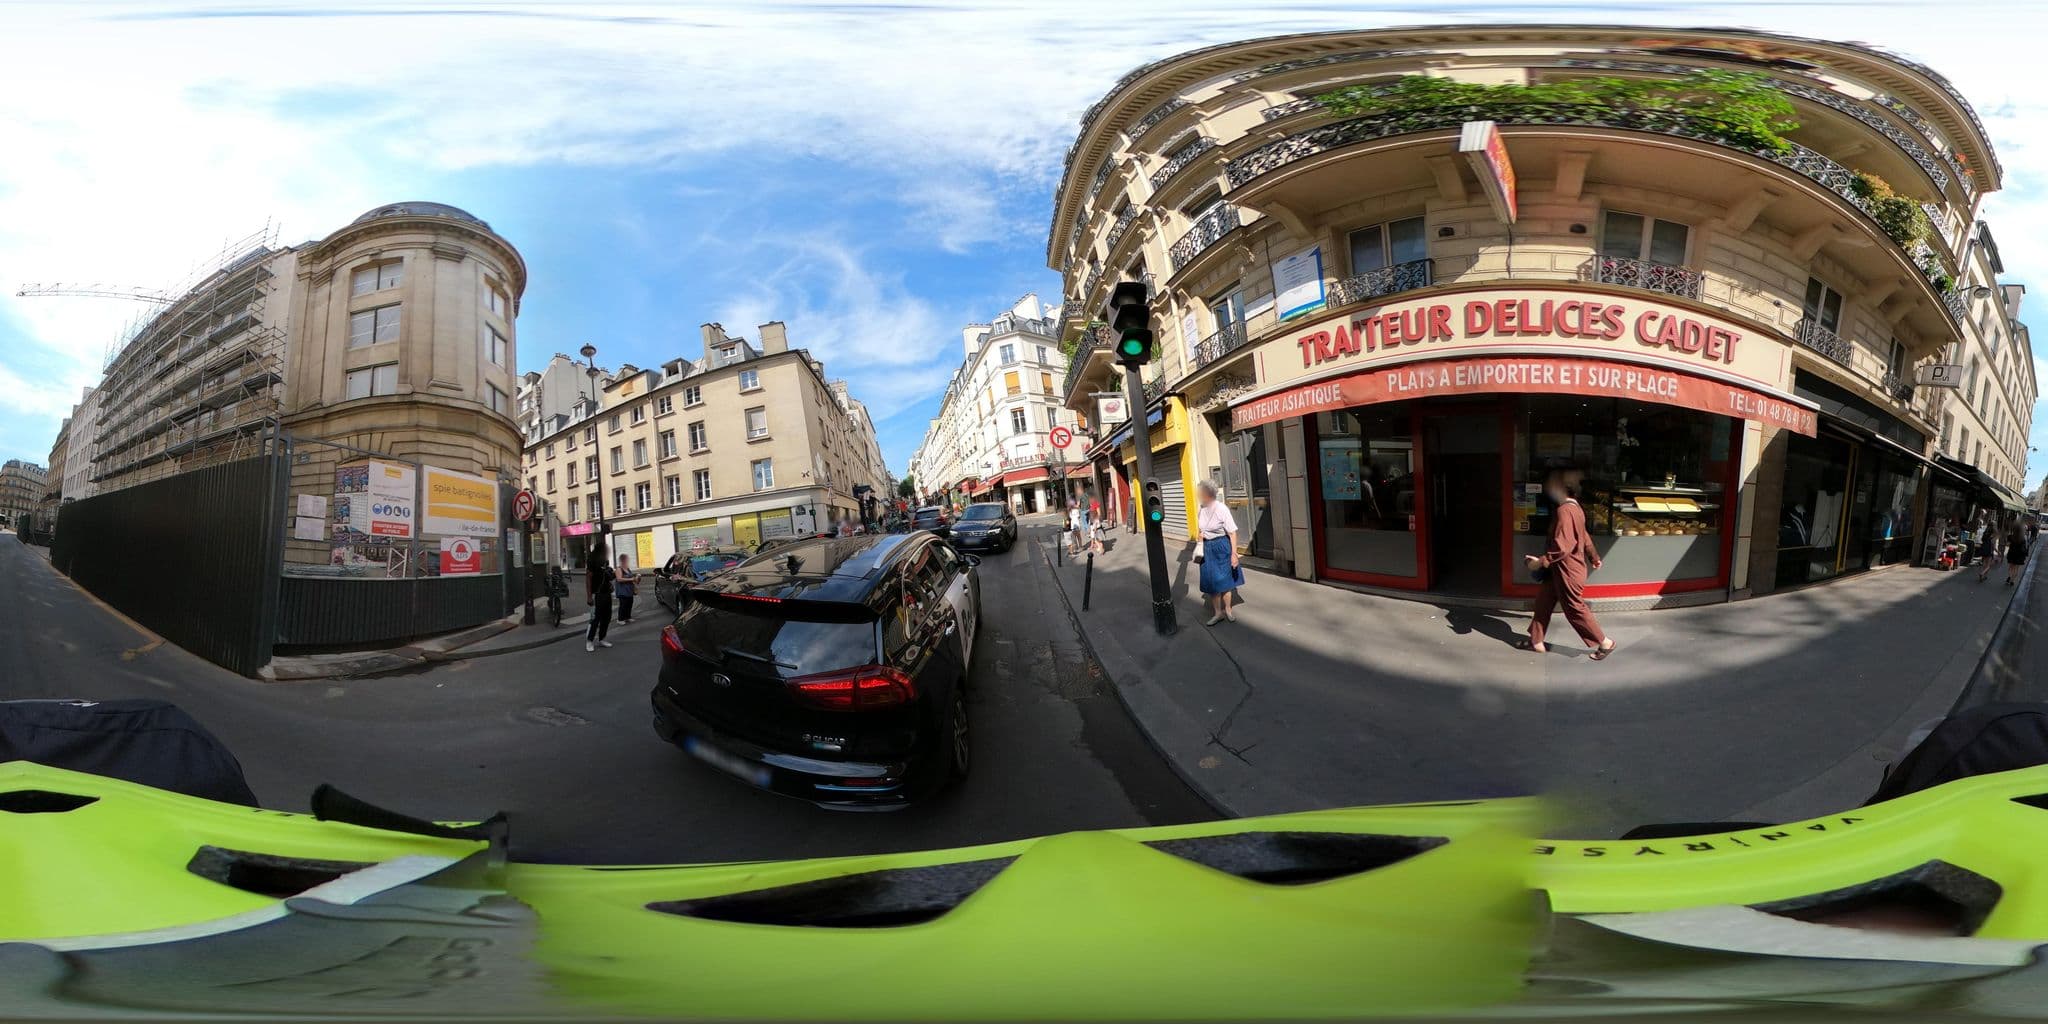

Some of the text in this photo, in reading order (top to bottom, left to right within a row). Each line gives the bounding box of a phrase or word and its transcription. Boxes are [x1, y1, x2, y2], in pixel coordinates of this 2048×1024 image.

[1298, 304, 1454, 366] TRAITEUR
[1465, 299, 1625, 338] DELICES
[1636, 310, 1742, 362] CADET
[1388, 363, 1679, 397] PLATS A EMPORTER ET SUR PLACE
[1237, 383, 1341, 425] TRAITEUR ASIATIQUE
[1728, 391, 1755, 413] TEL:
[1757, 399, 1767, 417] 01
[1770, 403, 1780, 420] 48
[433, 483, 451, 493] spie
